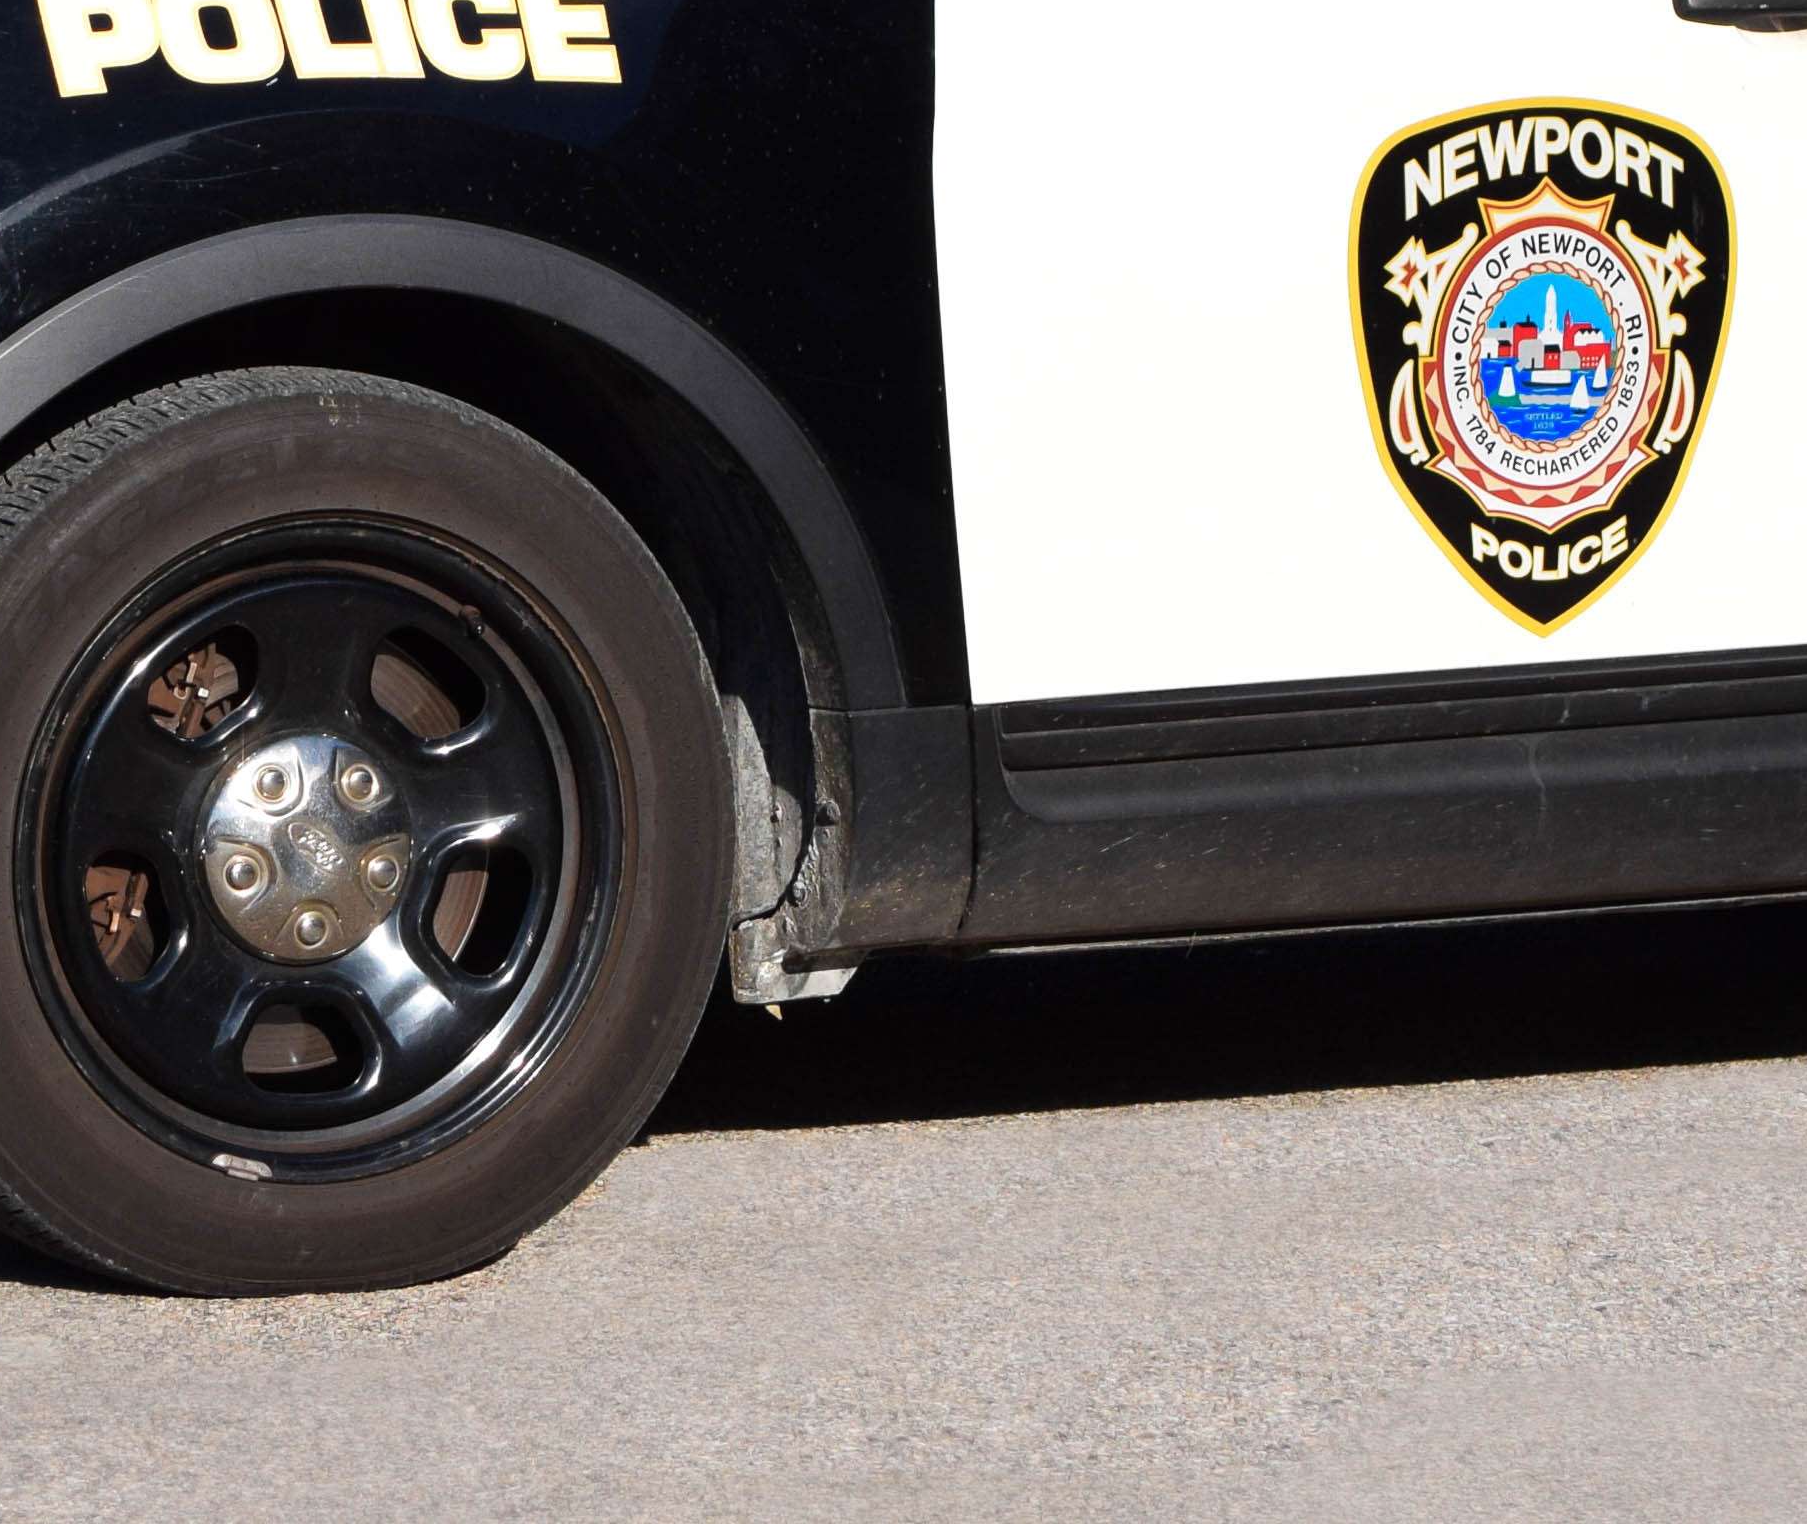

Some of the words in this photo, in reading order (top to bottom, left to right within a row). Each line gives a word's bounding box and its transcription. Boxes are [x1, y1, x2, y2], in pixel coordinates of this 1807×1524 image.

[1402, 116, 1684, 222] NEWPORT
[1451, 282, 1484, 345] CITY
[1485, 246, 1513, 280] OF
[1521, 232, 1626, 289] NEWPORT
[1624, 313, 1643, 341] RI
[1453, 365, 1471, 410] INC.
[1465, 414, 1497, 456] 1784
[1500, 416, 1619, 477] RECHARTERED
[1617, 360, 1640, 409] 1853
[1470, 515, 1630, 581] POLICE
